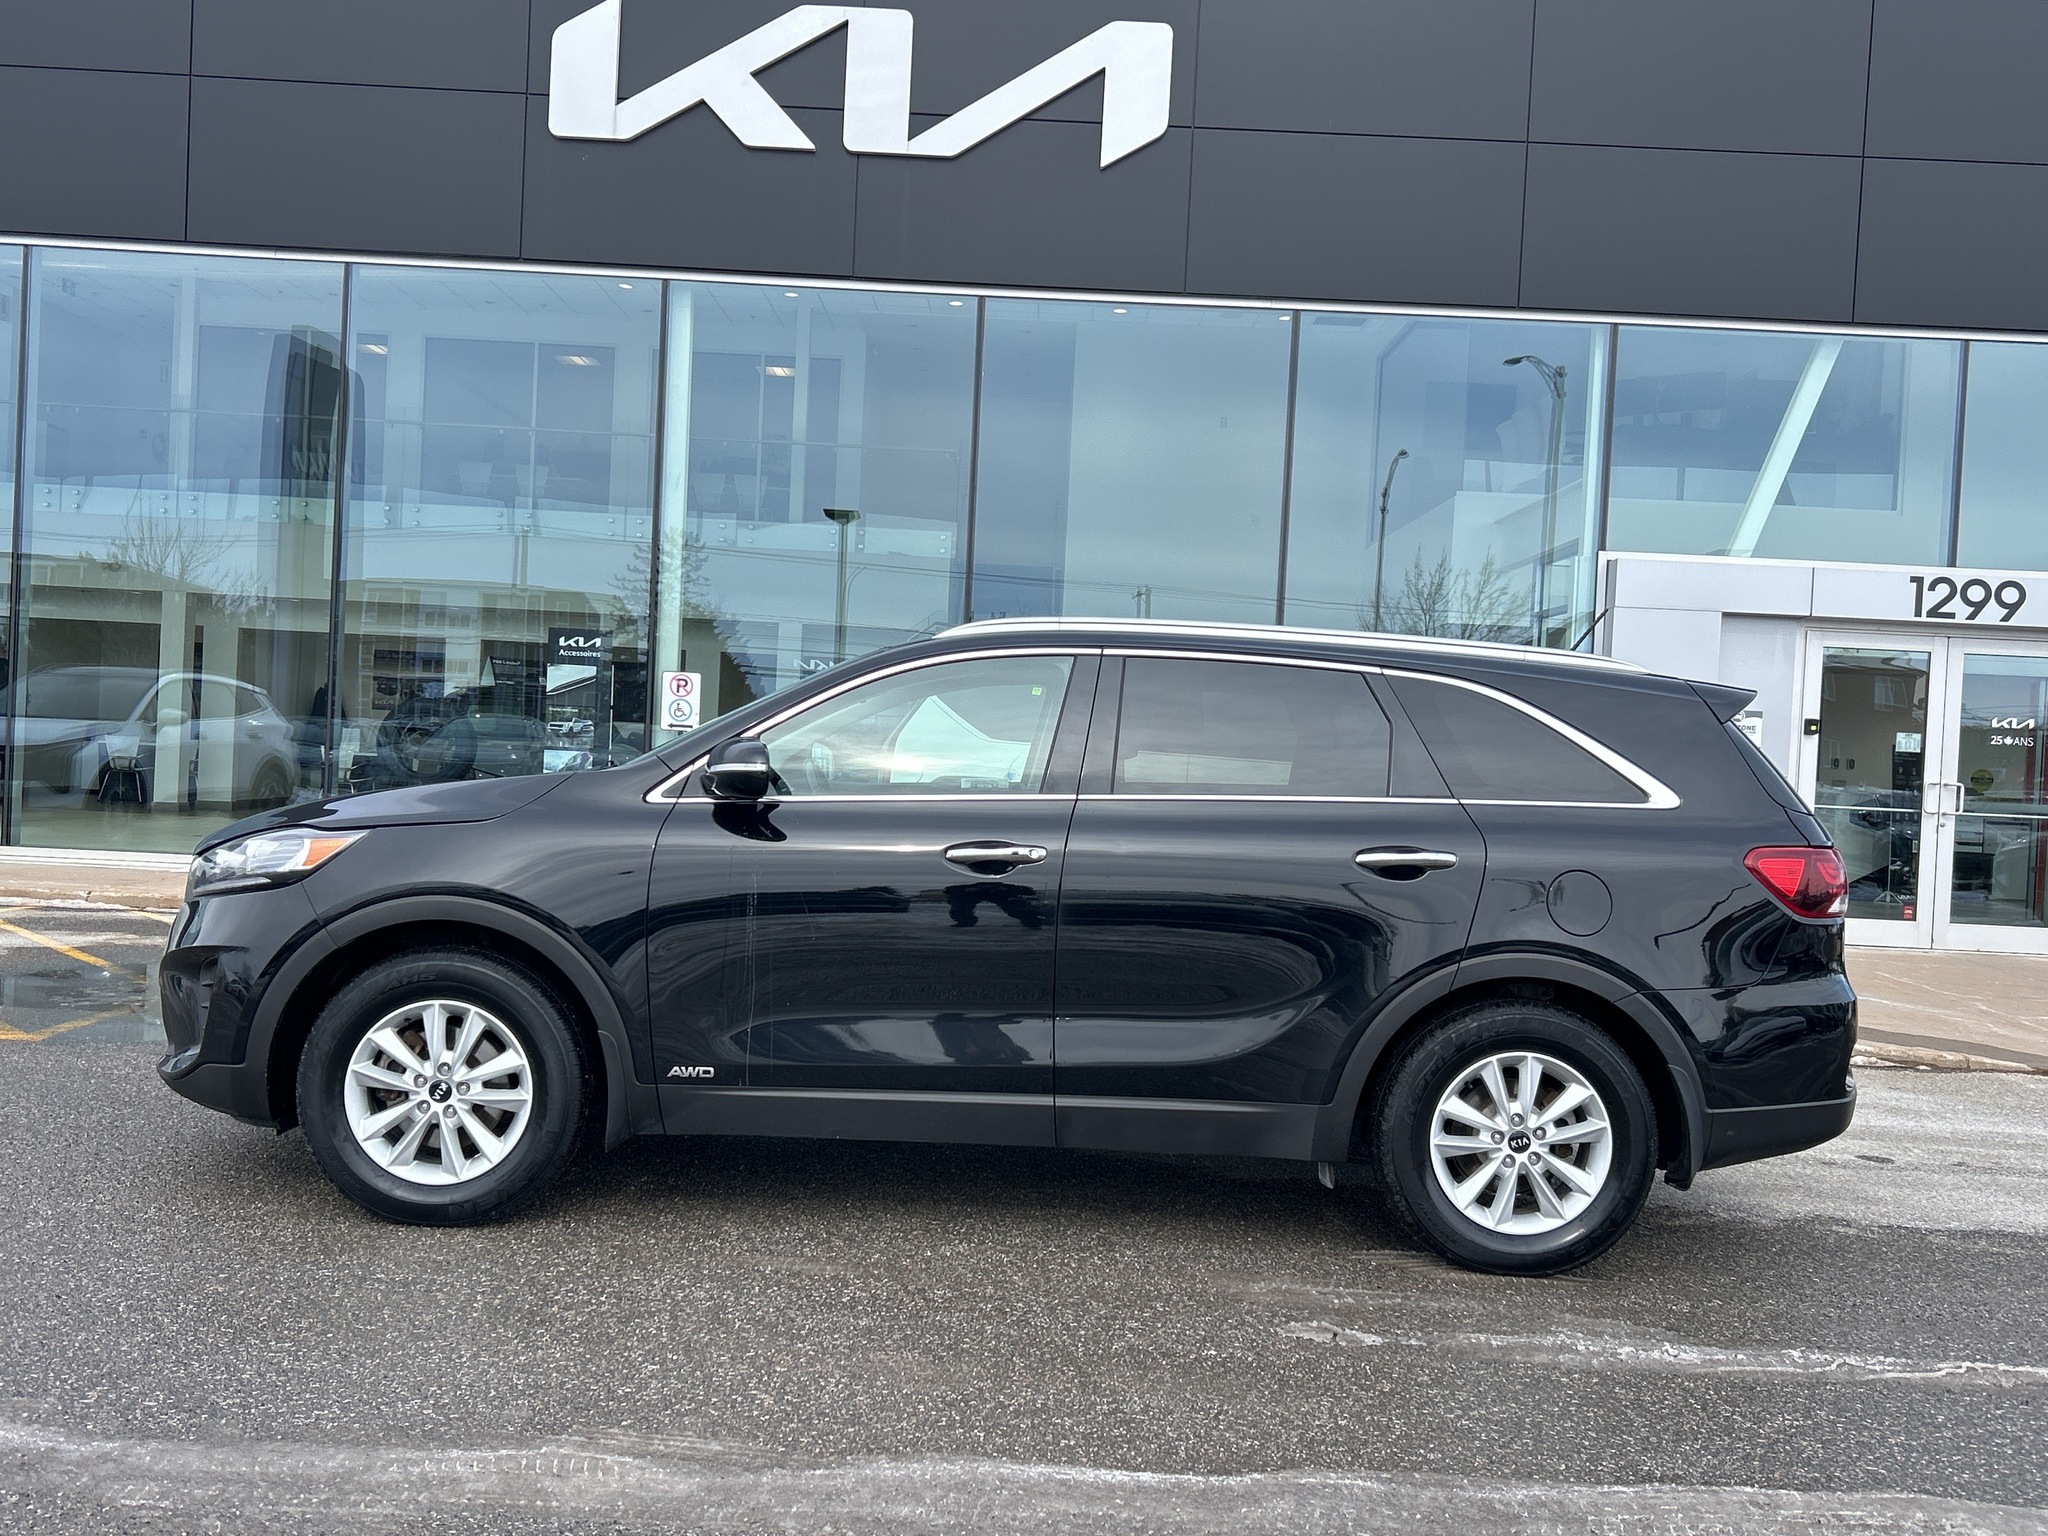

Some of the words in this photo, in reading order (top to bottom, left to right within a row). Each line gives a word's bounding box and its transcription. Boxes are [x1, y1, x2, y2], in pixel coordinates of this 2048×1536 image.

[548, 0, 1174, 169] KIA
[1909, 575, 2027, 622] 1299
[559, 635, 602, 648] KIA
[558, 648, 601, 658] Accessoires
[1738, 724, 1757, 732] ONE
[1991, 716, 2036, 730] KIA
[1990, 735, 2003, 745] 25
[2012, 736, 2035, 747] ANS
[666, 1066, 715, 1078] AWD
[431, 1082, 449, 1100] KIA
[1510, 1136, 1530, 1148] KIA
